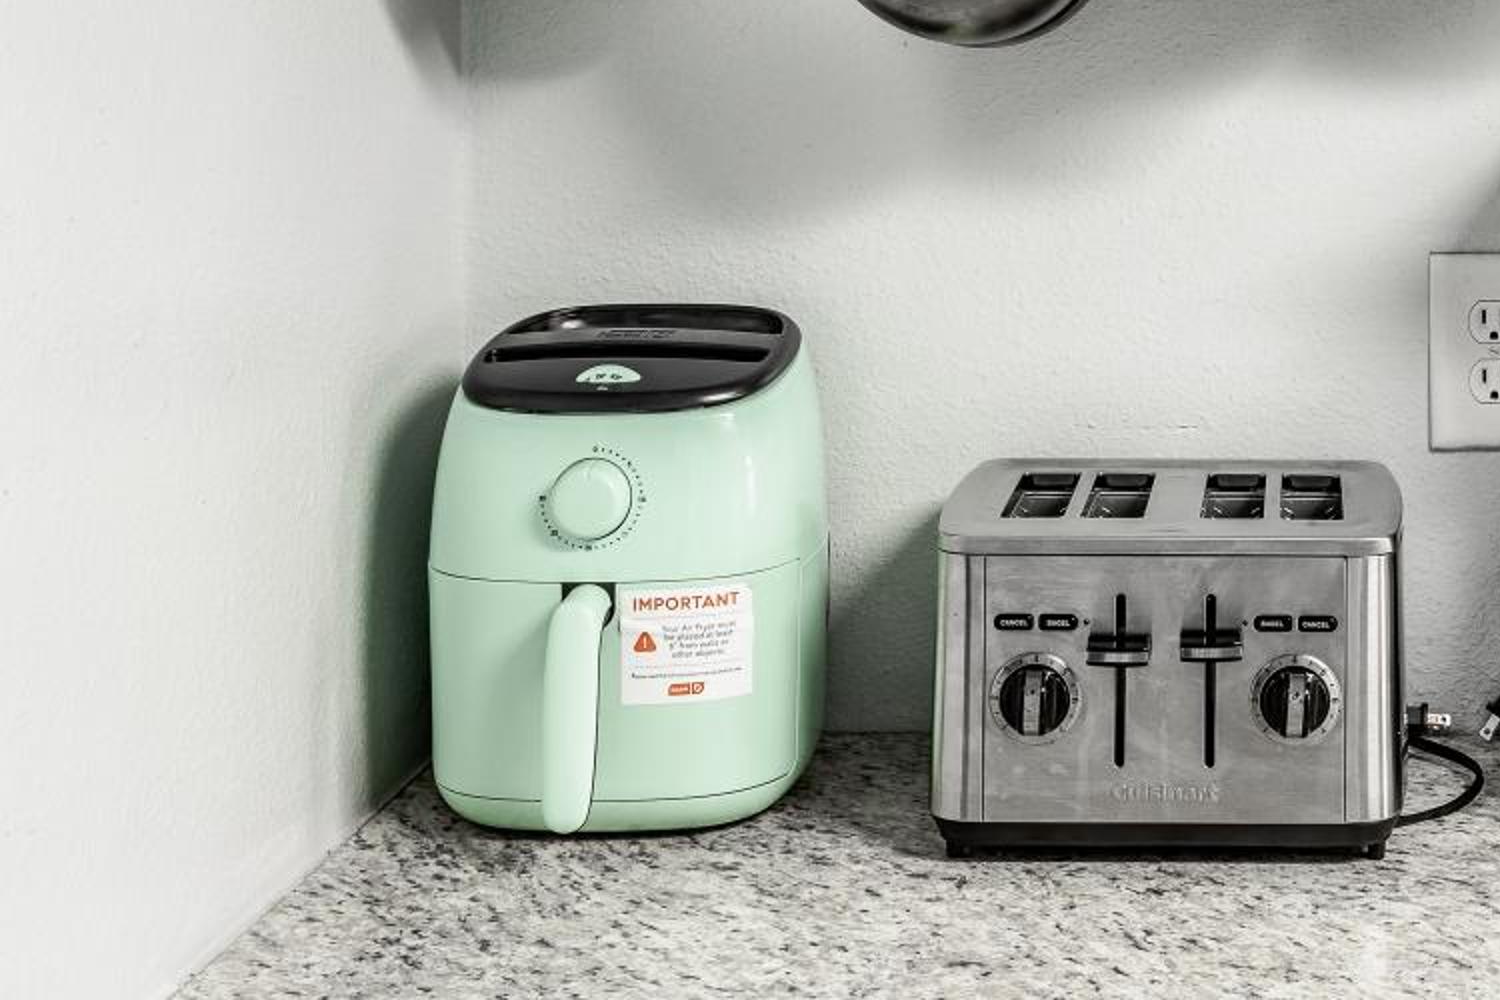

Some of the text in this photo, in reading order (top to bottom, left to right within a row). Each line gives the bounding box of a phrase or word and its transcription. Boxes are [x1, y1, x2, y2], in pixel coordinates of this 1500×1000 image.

[633, 591, 740, 612] IMPORTANT
[1000, 618, 1029, 628] CANCEL
[1301, 620, 1331, 629] CANCEL
